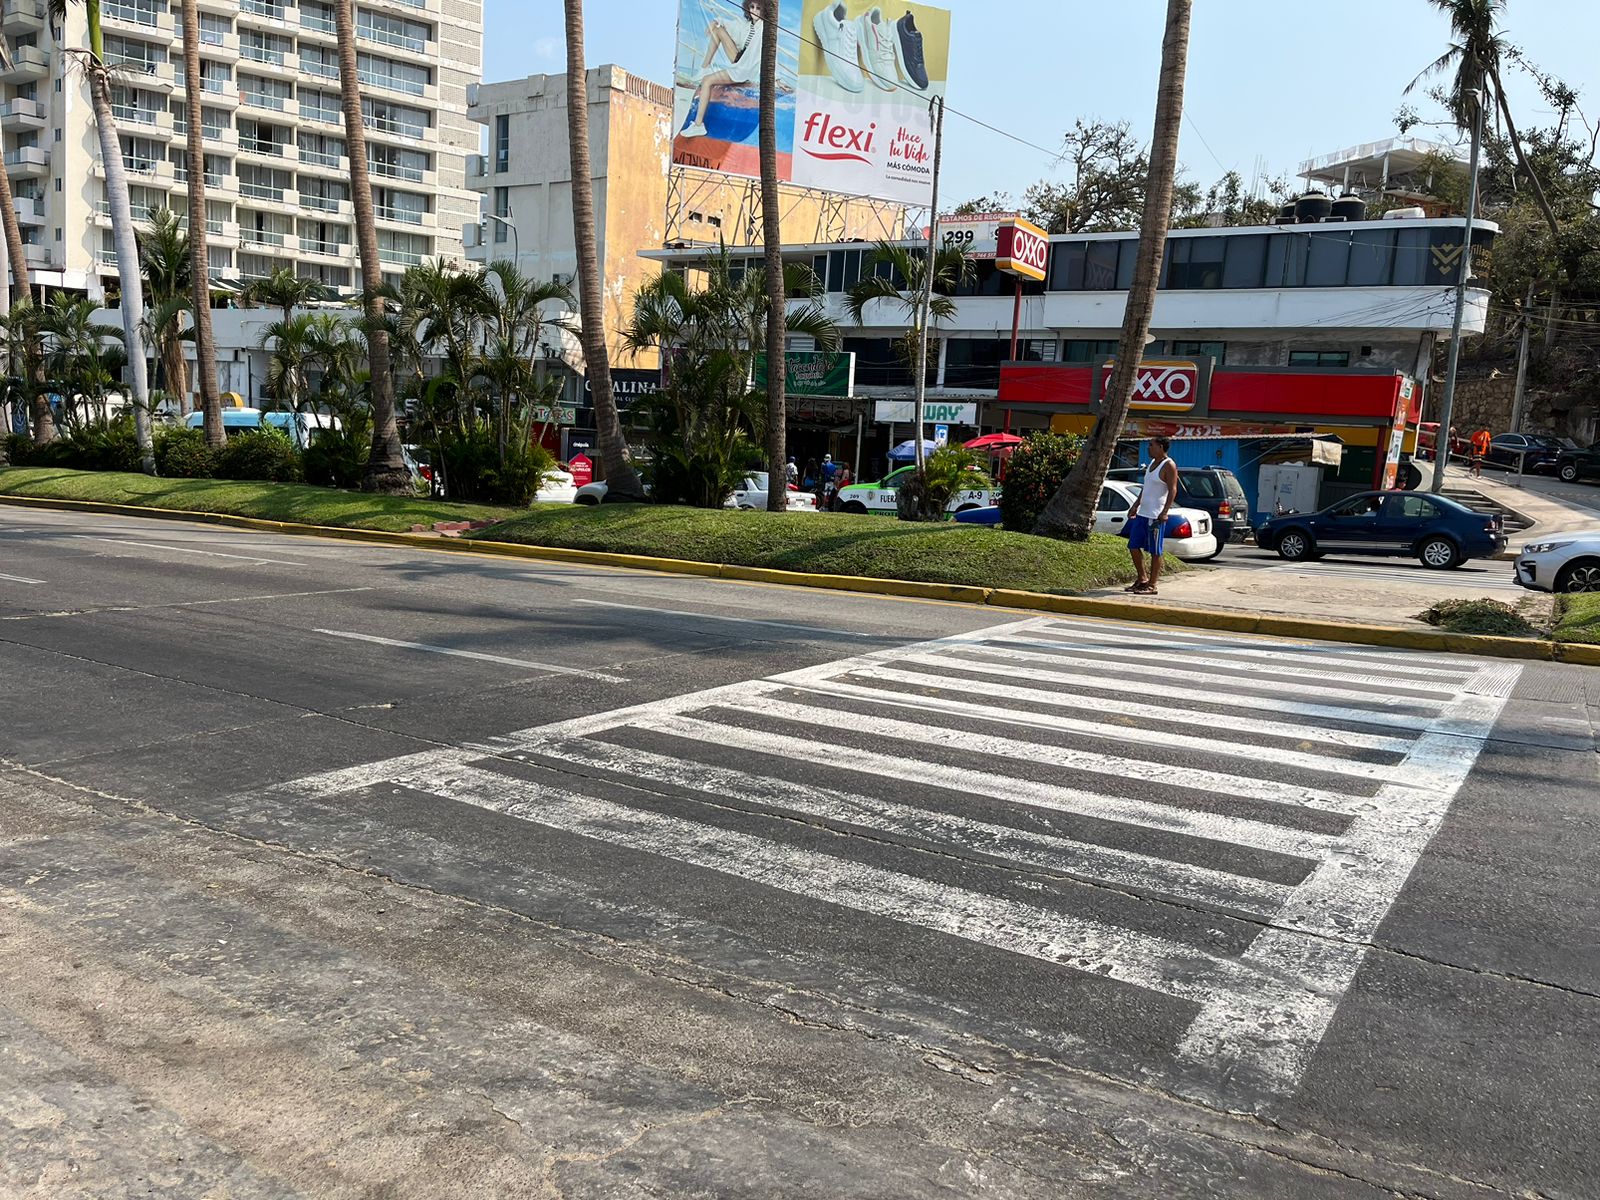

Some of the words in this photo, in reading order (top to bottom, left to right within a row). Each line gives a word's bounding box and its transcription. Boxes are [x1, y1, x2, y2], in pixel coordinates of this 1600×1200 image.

[803, 112, 876, 152] flexi
[897, 126, 921, 143] Hace
[904, 143, 930, 163] Vida
[887, 161, 901, 170] MÁS
[902, 164, 931, 174] CÓMODA
[941, 214, 973, 222] ESTAMOS
[1014, 230, 1047, 269] OXXO
[585, 380, 656, 394] CALINA
[1105, 367, 1191, 400] XXO
[968, 491, 983, 500] A-9
